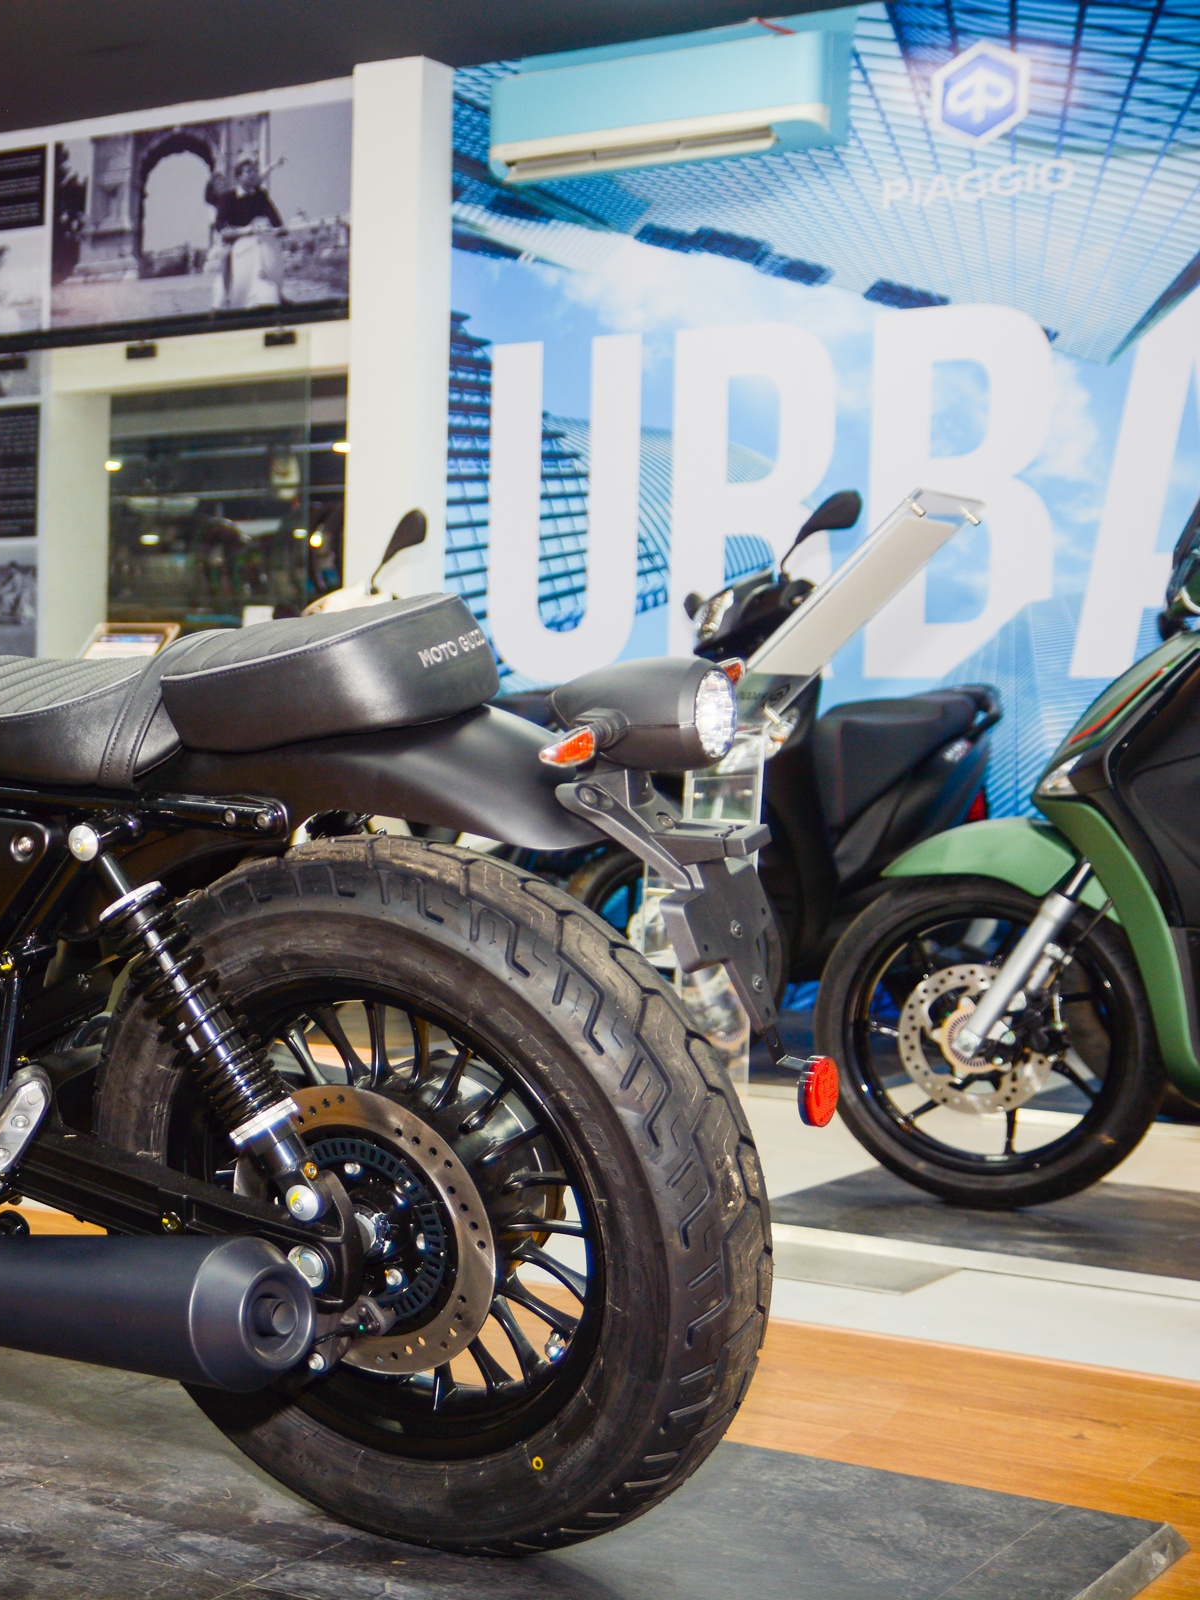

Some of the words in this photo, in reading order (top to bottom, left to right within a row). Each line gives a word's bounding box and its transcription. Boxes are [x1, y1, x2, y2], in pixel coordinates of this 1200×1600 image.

[881, 158, 1076, 210] PIAGGIO
[417, 640, 458, 668] MOTO
[458, 629, 486, 652] GUZZ
[485, 1007, 627, 1186] DUNLOP
